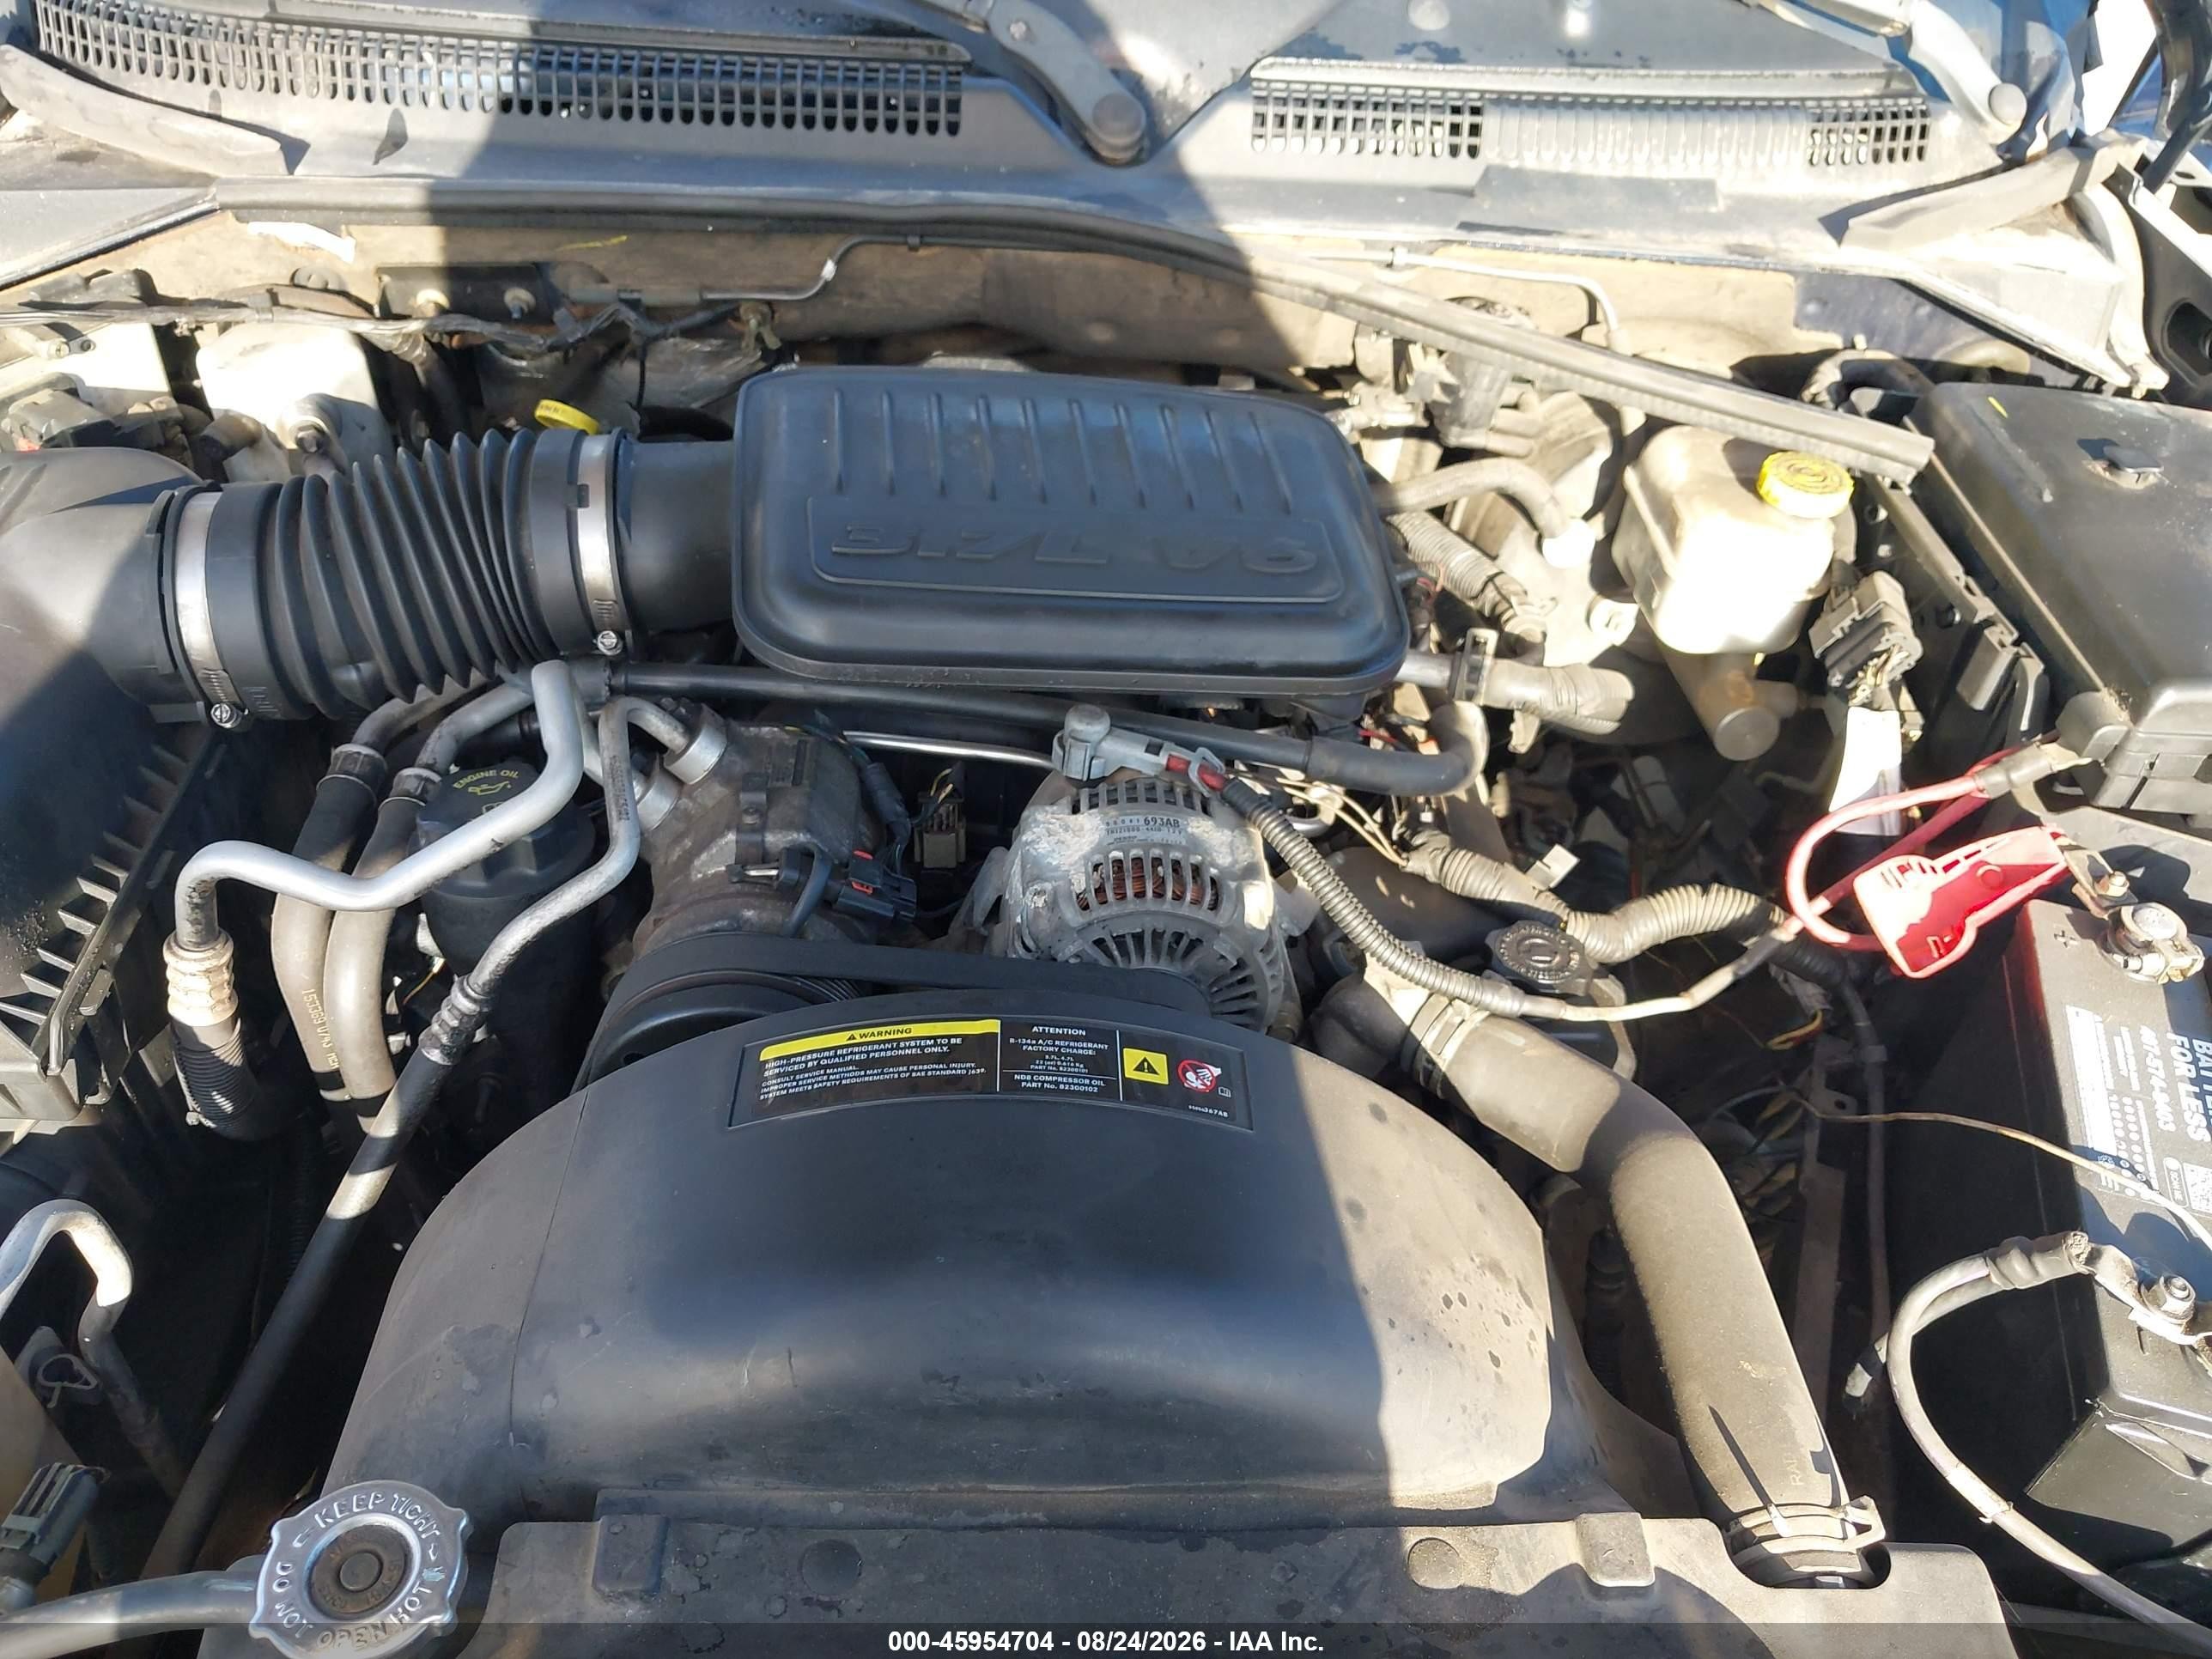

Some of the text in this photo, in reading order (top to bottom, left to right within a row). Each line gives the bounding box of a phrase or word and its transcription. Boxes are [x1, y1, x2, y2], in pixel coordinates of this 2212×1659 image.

[453, 769, 520, 789] ENGINE OIL
[859, 1028, 912, 1039] WARNING
[1032, 1026, 1085, 1036] ATTENTION
[765, 1048, 836, 1069] HIGH-PRESSURE
[836, 1042, 897, 1055] REFRIGERANT
[899, 1039, 933, 1048] SYSTEM
[1055, 1041, 1109, 1050] REFRIGERANT
[763, 1063, 805, 1077] SERVICED
[820, 1054, 867, 1066] QUALIFIED
[869, 1048, 922, 1059] PERSONNEL
[760, 1090, 787, 1100] SYSTEM
[788, 1085, 812, 1094] MEETS
[842, 1074, 898, 1085] REQUIREMENTS
[761, 1081, 797, 1093] IMPROPER
[798, 1076, 827, 1085] SERVICE
[830, 1071, 865, 1079] METHODS
[762, 1076, 793, 1087] CONSULT
[795, 1069, 824, 1079] SERVICE
[1033, 1075, 1090, 1085] COMPRESSOR
[2166, 1032, 2212, 1142] FOR LESS
[314, 1491, 441, 1540] KEEP TIGHT
[272, 1561, 294, 1593] DO
[275, 1600, 314, 1638] NOT
[390, 1581, 434, 1631] HOT
[316, 1620, 388, 1650] OPEN
